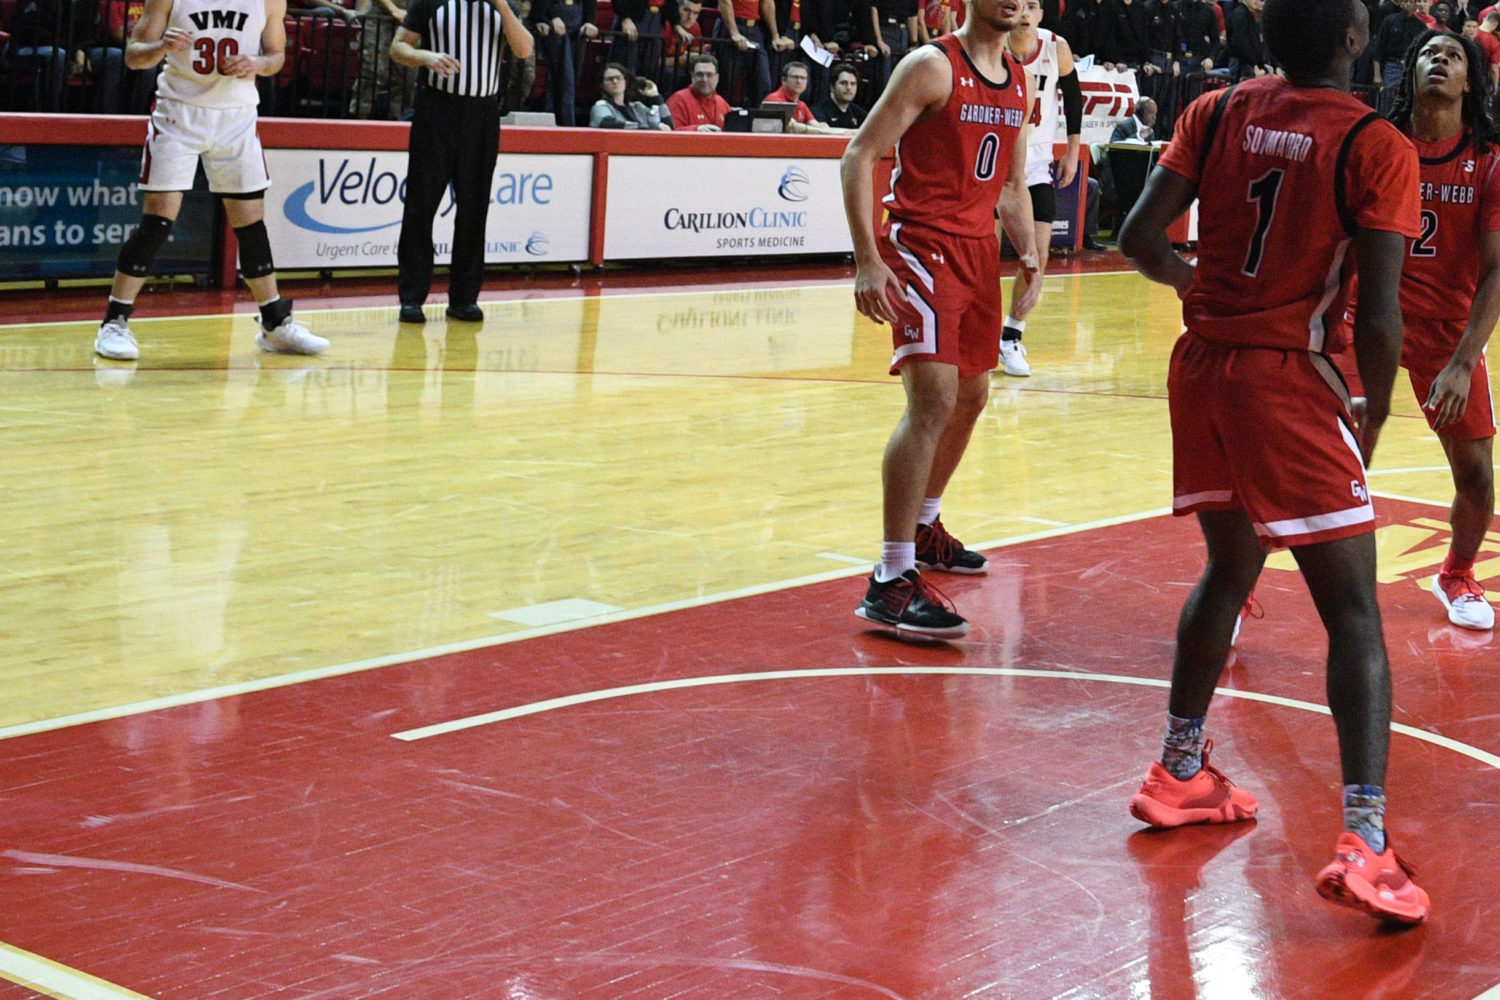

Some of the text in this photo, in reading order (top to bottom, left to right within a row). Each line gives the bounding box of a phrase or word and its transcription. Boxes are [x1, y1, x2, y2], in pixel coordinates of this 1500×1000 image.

[189, 10, 249, 32] VMI
[193, 37, 239, 76] 30
[974, 132, 1000, 181] 0
[67, 178, 139, 206] what
[54, 220, 85, 245] to
[1241, 168, 1285, 278] 1
[316, 242, 359, 260] Urgent
[363, 241, 391, 256] Care
[716, 236, 806, 249] SPORTS MEDICINE
